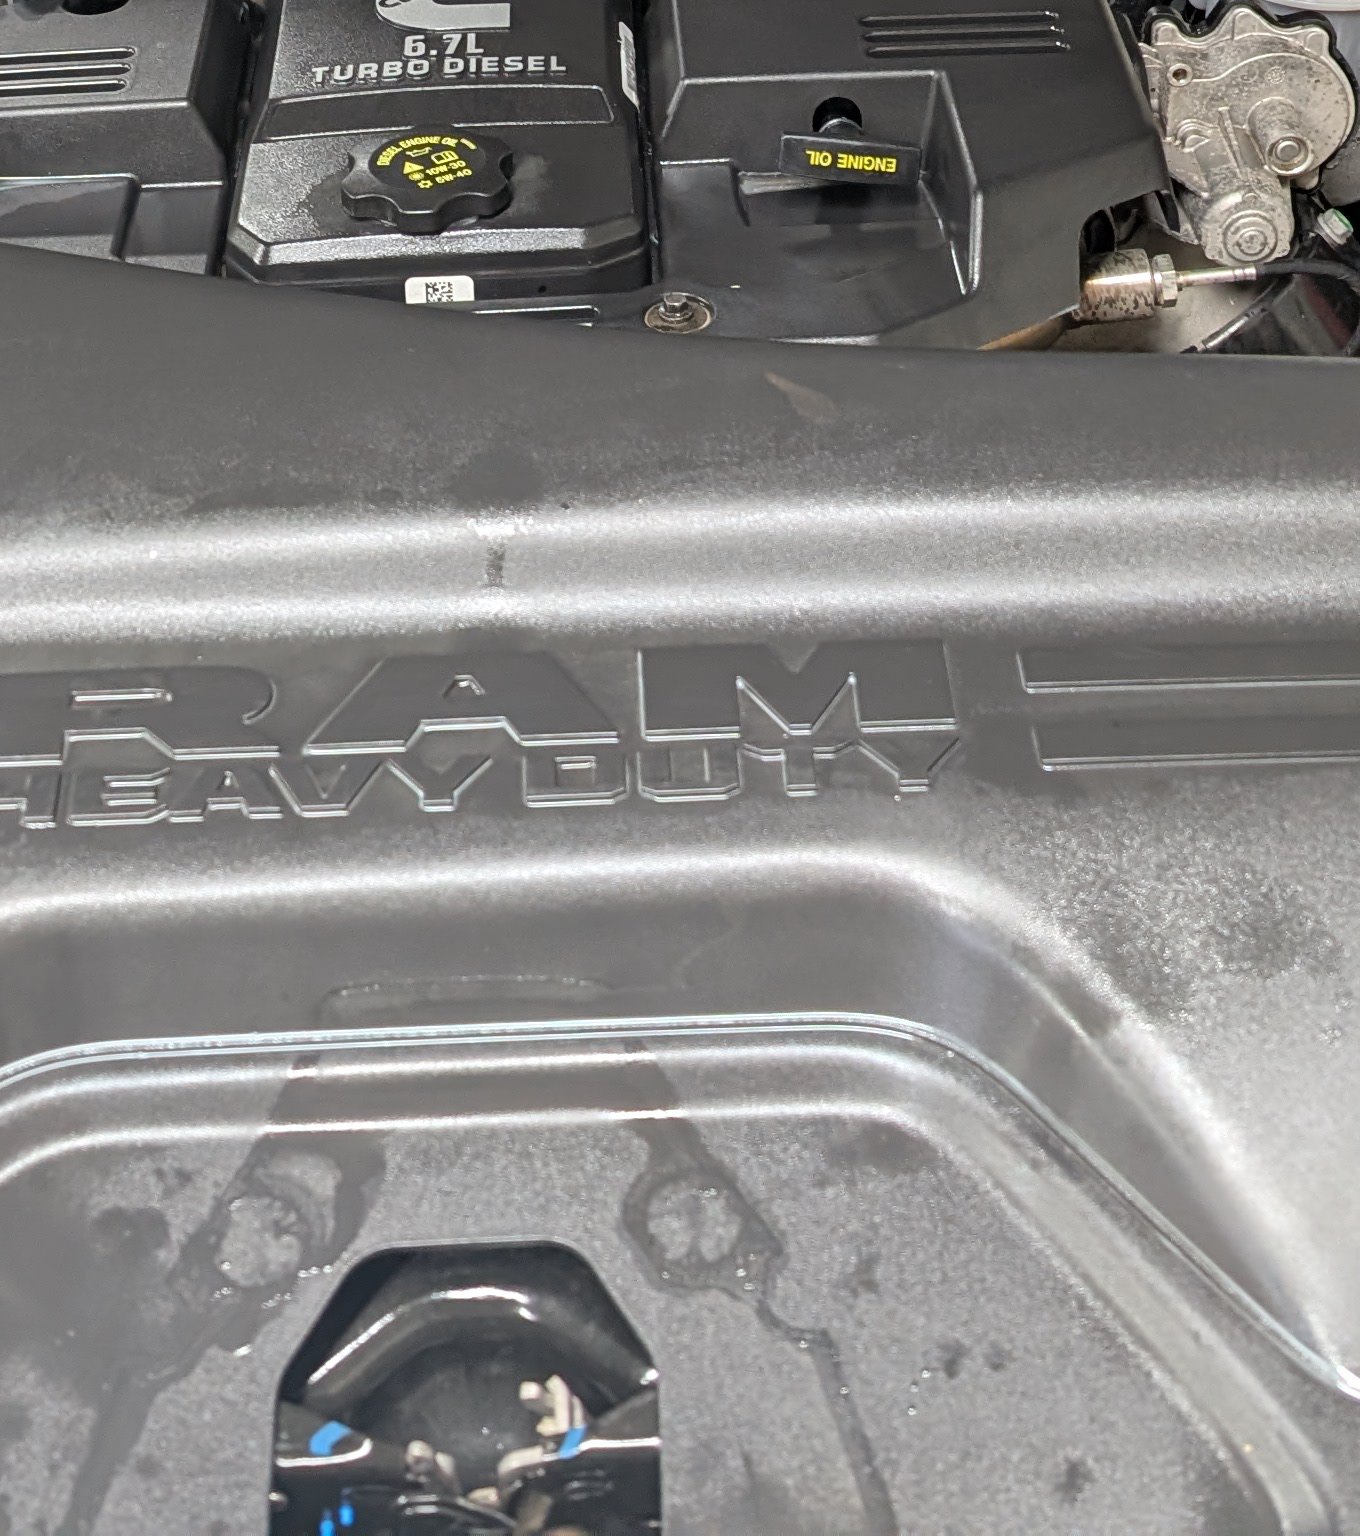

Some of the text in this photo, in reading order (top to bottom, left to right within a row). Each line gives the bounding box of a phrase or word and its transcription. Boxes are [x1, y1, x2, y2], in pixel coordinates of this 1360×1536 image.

[404, 32, 484, 57] 6.7L
[311, 56, 567, 83] TURBO DIESEL
[376, 145, 403, 166] DIESEL
[399, 135, 441, 149] ENGINE
[805, 150, 897, 173] ENGINE OIL
[425, 160, 466, 176] 10W-30
[522, 738, 961, 808] DUTY
